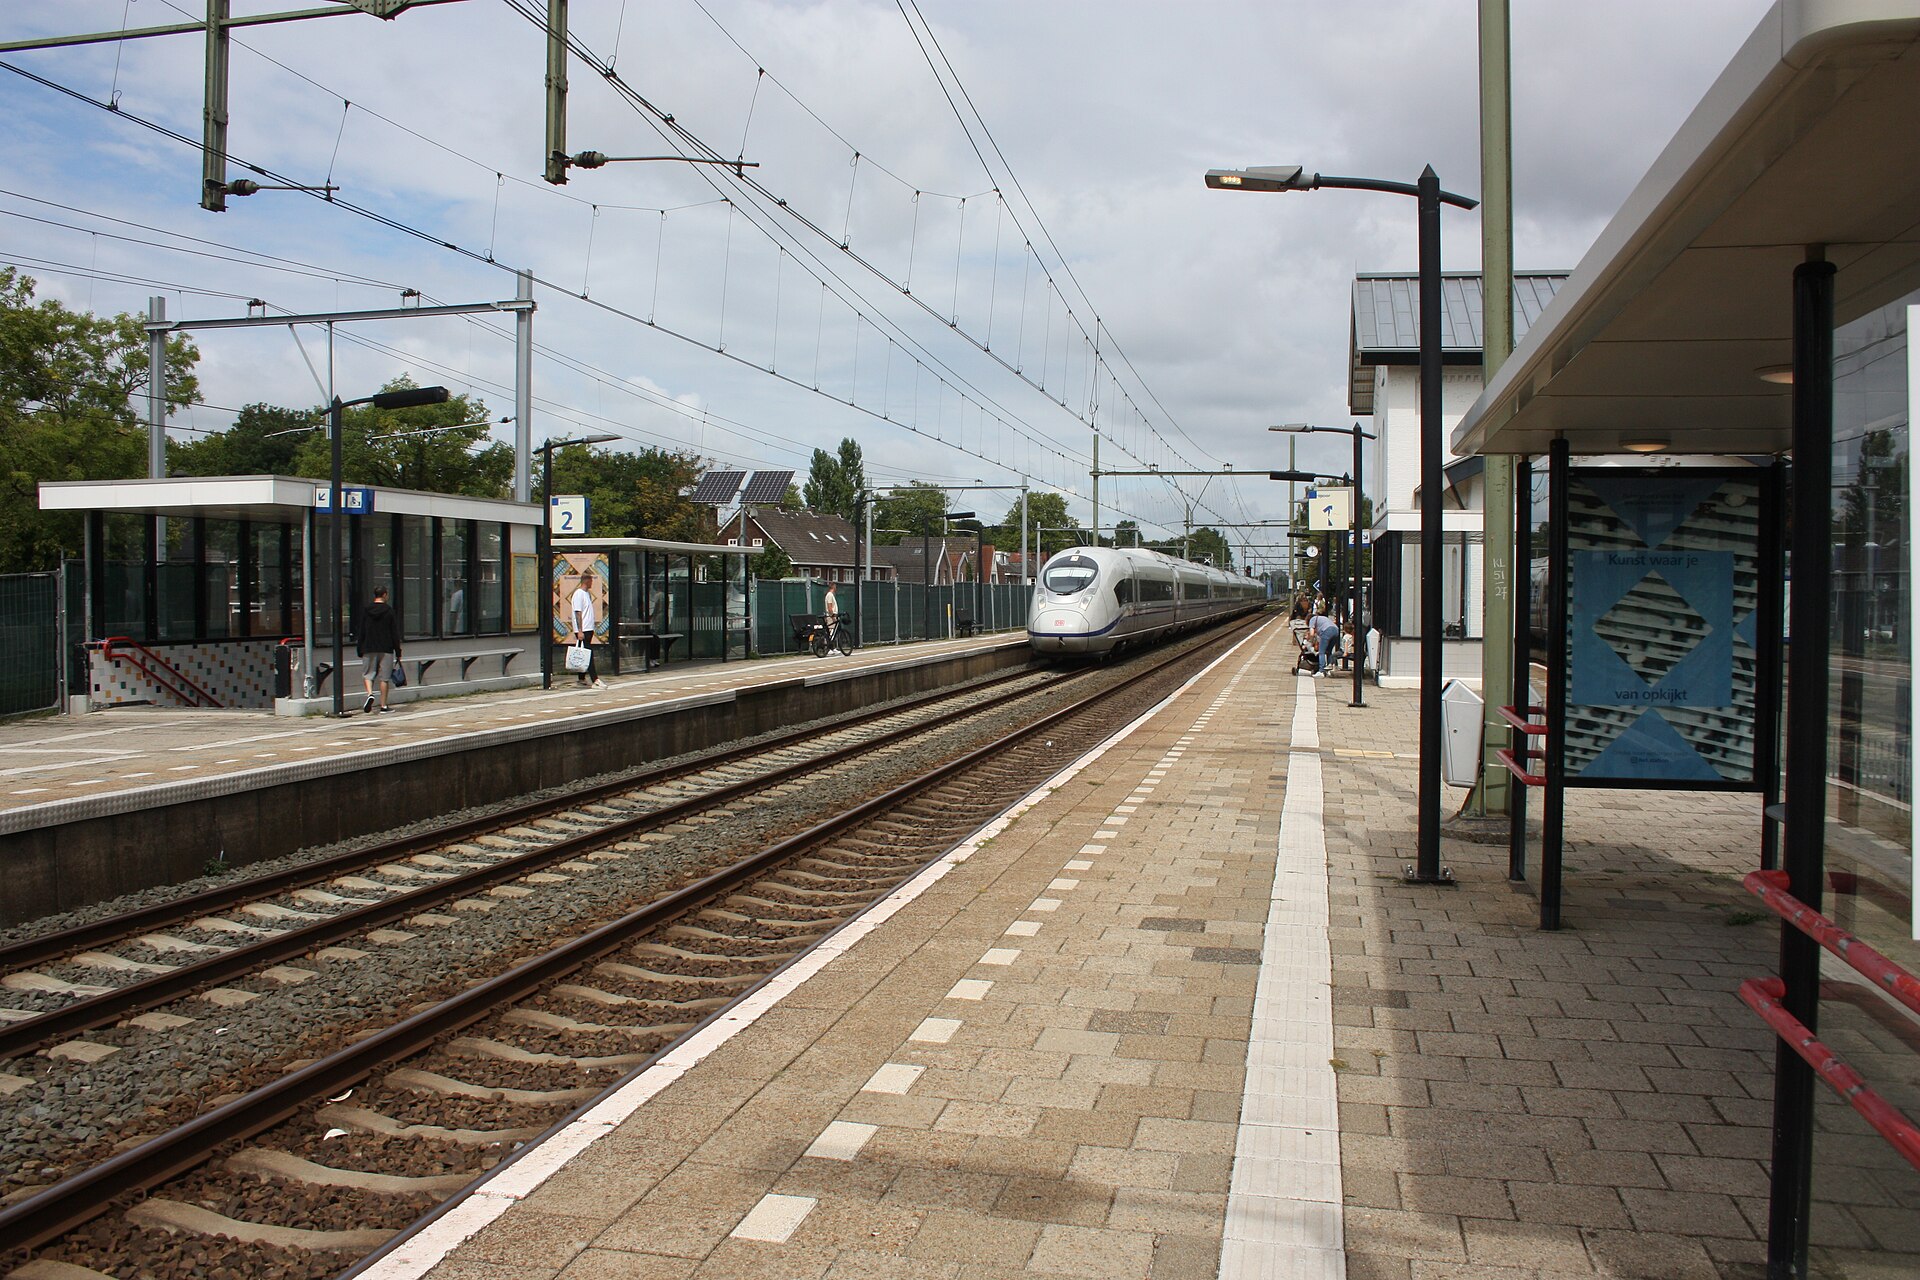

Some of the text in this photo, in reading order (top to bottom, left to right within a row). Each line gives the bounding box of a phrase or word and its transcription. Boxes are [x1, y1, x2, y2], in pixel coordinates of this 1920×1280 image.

[561, 511, 573, 530] 2
[1492, 557, 1506, 568] KL
[1608, 554, 1699, 568] Kunst waar je
[1493, 570, 1505, 580] 51
[1615, 688, 1688, 703] van opkijkt
